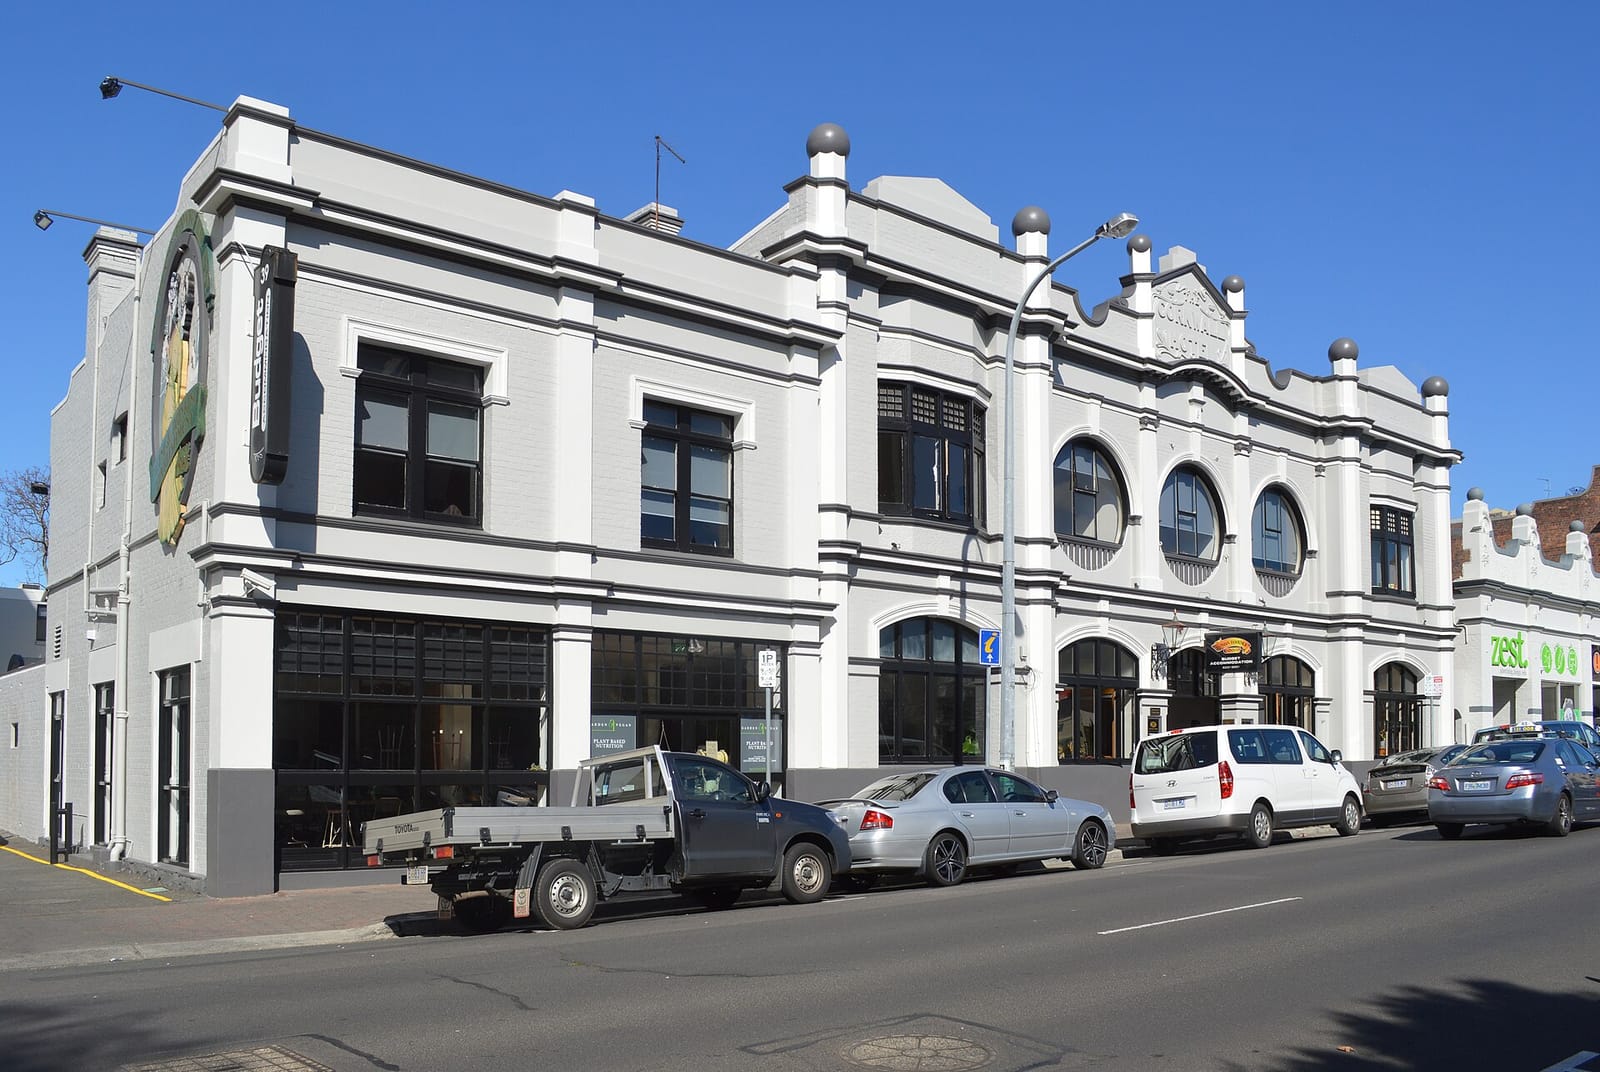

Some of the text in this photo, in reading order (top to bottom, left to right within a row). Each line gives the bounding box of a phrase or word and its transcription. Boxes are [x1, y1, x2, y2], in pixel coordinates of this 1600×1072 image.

[252, 298, 264, 429] Budget
[762, 654, 773, 663] 1P
[395, 824, 413, 834] TOYOTA
